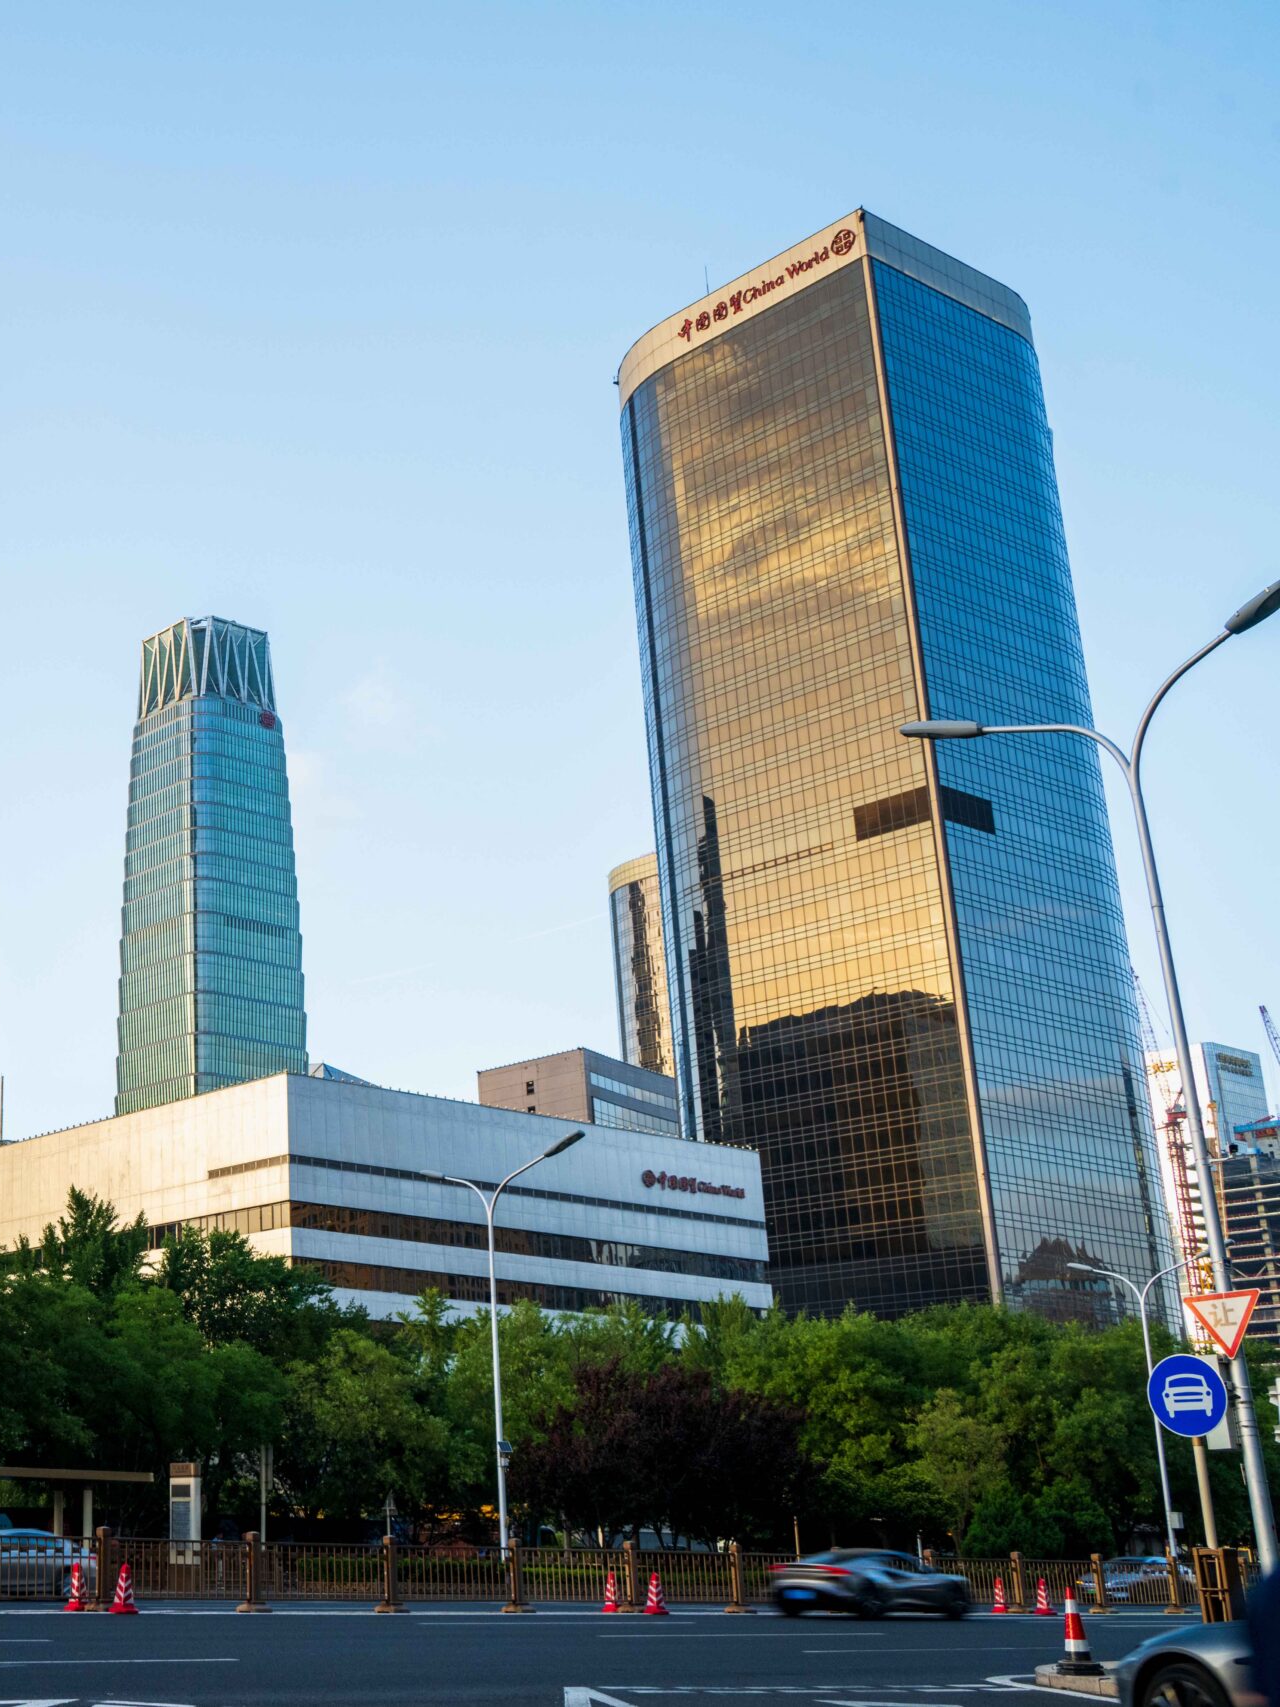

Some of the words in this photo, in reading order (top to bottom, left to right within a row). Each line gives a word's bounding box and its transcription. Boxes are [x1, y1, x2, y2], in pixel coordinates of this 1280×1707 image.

[742, 274, 785, 304] China
[785, 246, 830, 279] World
[1208, 1301, 1237, 1328] 让
